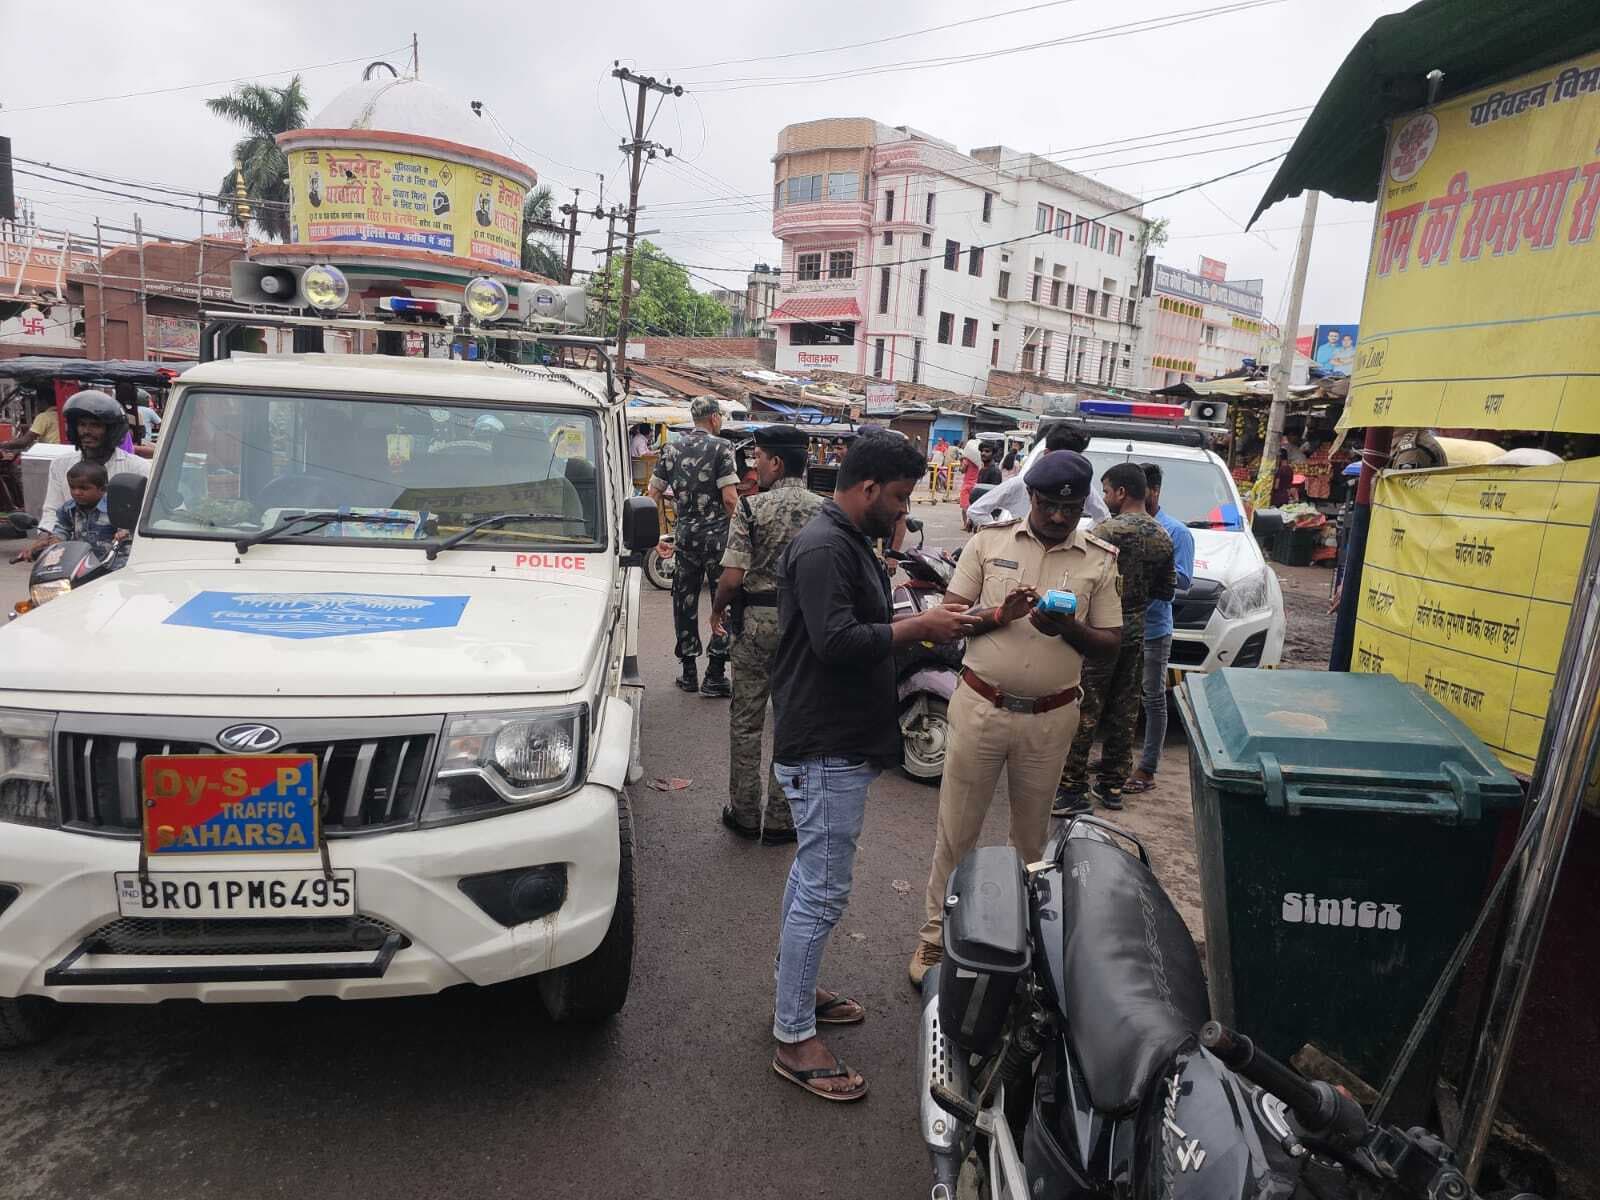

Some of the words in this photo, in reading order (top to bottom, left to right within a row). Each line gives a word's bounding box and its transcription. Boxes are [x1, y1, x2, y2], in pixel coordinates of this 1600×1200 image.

[1469, 81, 1552, 127] परिवहन
[1420, 171, 1468, 268] की
[1459, 164, 1578, 262] समस्या
[516, 555, 585, 570] POLICE
[1475, 536, 1495, 567] चौक
[219, 801, 296, 819] TRAFFIC
[157, 823, 306, 847] SAHARSA
[141, 877, 350, 909] BR01PM6495
[1282, 892, 1402, 930] Sintex
